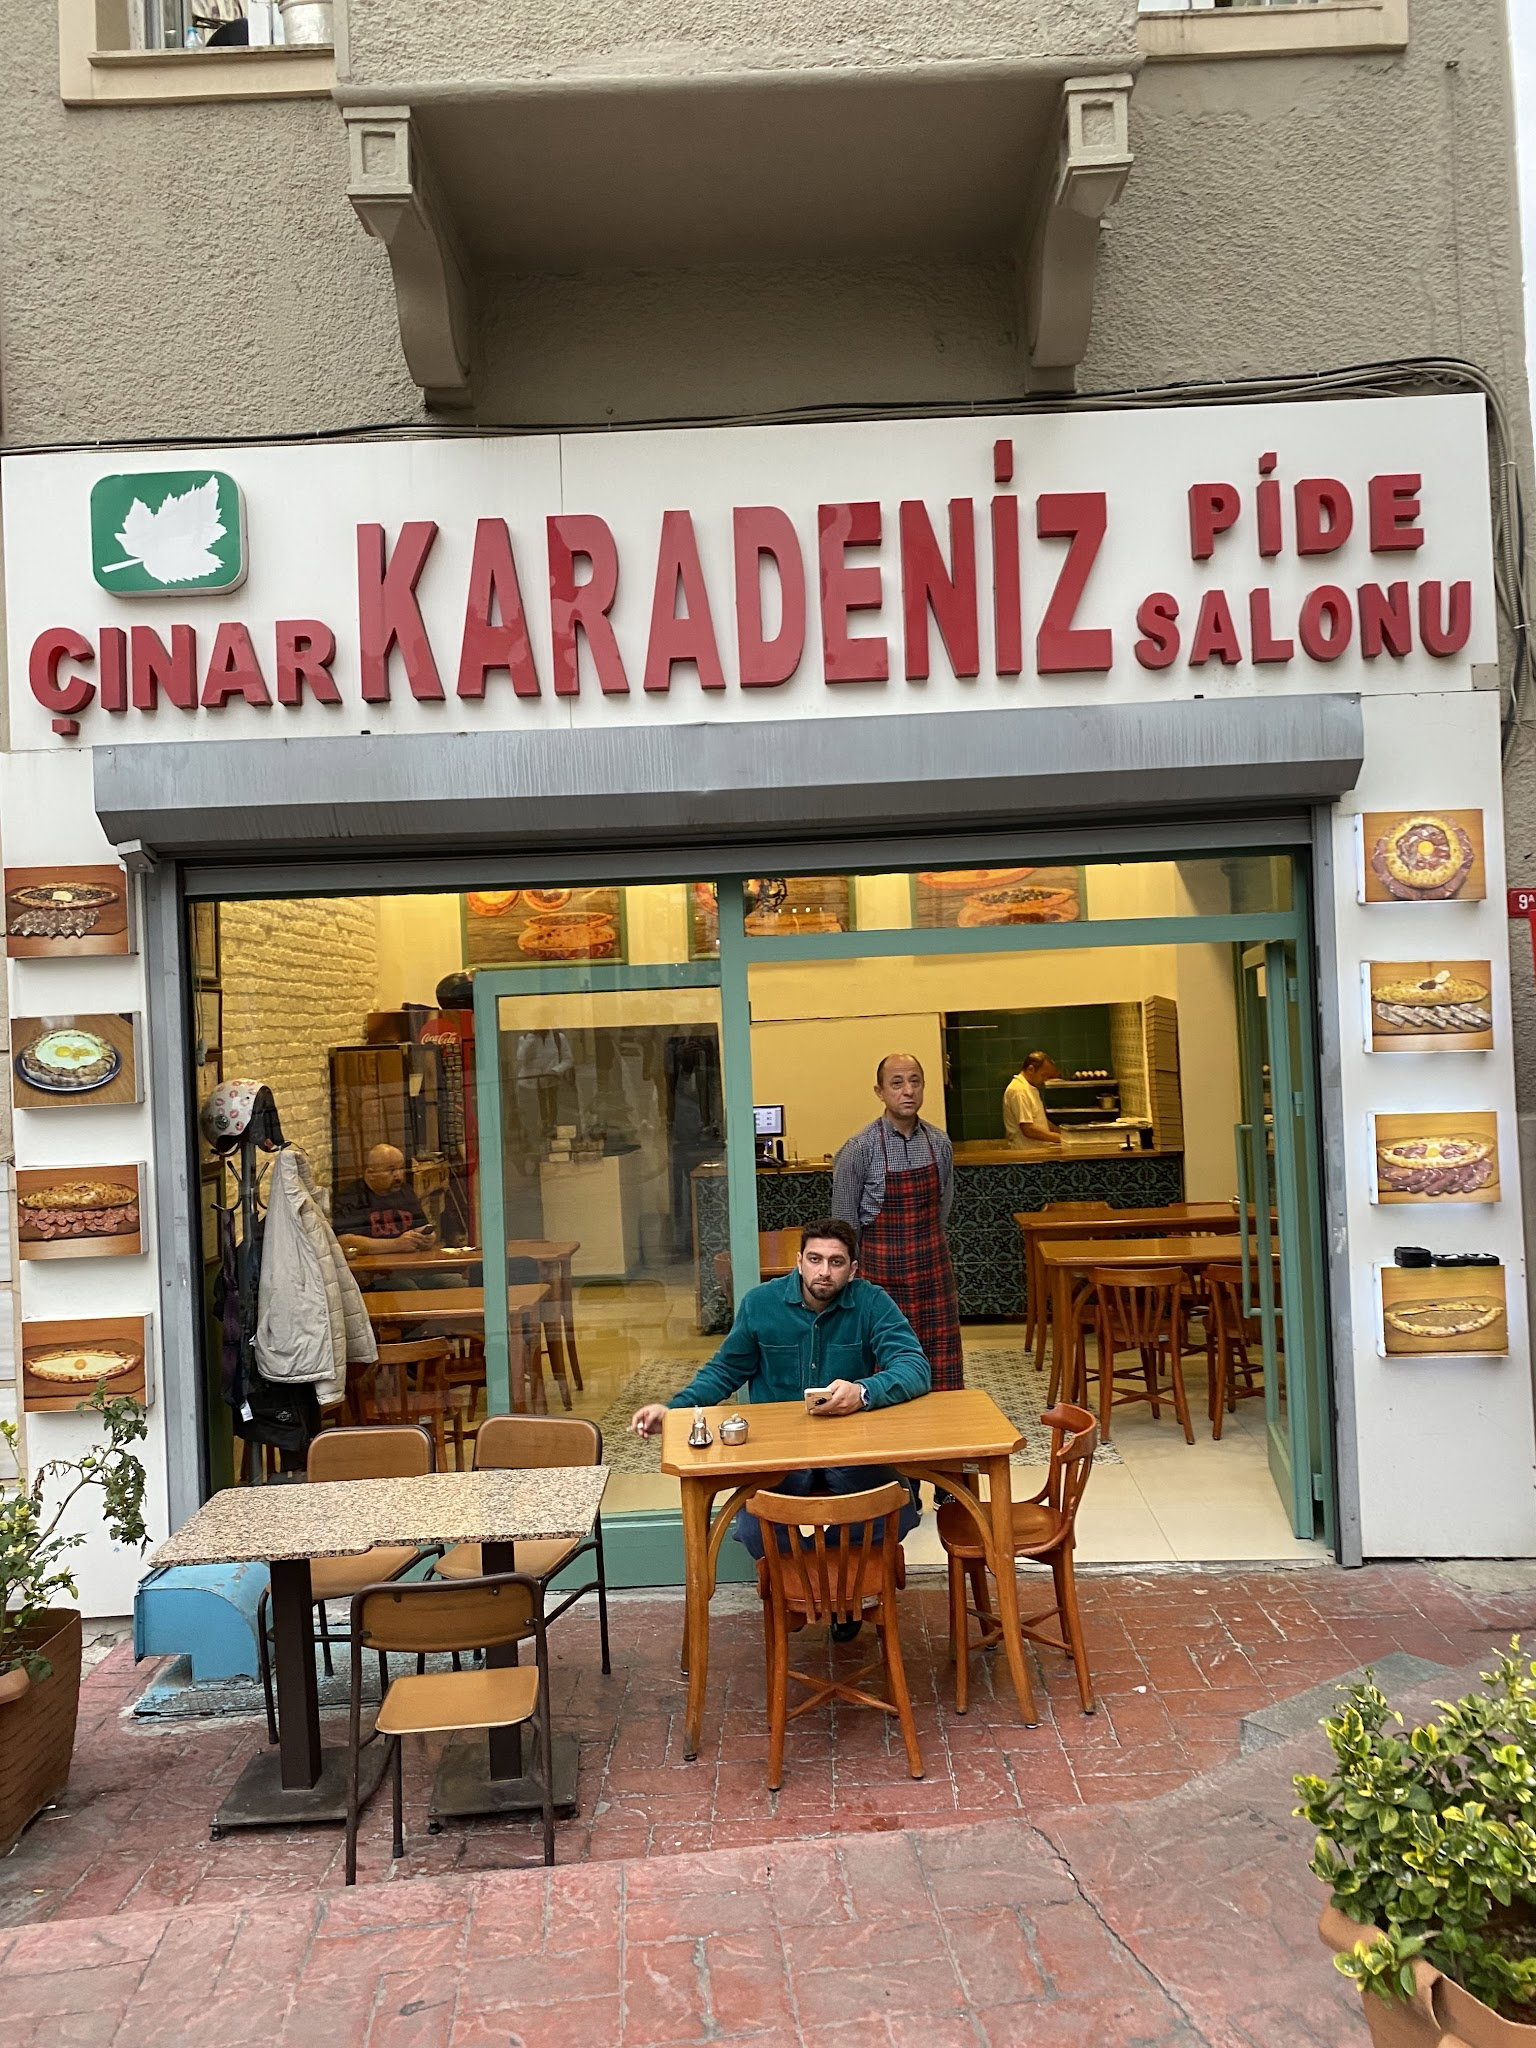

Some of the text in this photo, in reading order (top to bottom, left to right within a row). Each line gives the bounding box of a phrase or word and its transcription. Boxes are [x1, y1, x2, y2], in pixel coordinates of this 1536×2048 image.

[1187, 451, 1426, 561] PİDE
[28, 439, 1114, 737] ÇINAR KARADENİZ
[1134, 580, 1472, 670] SALONU
